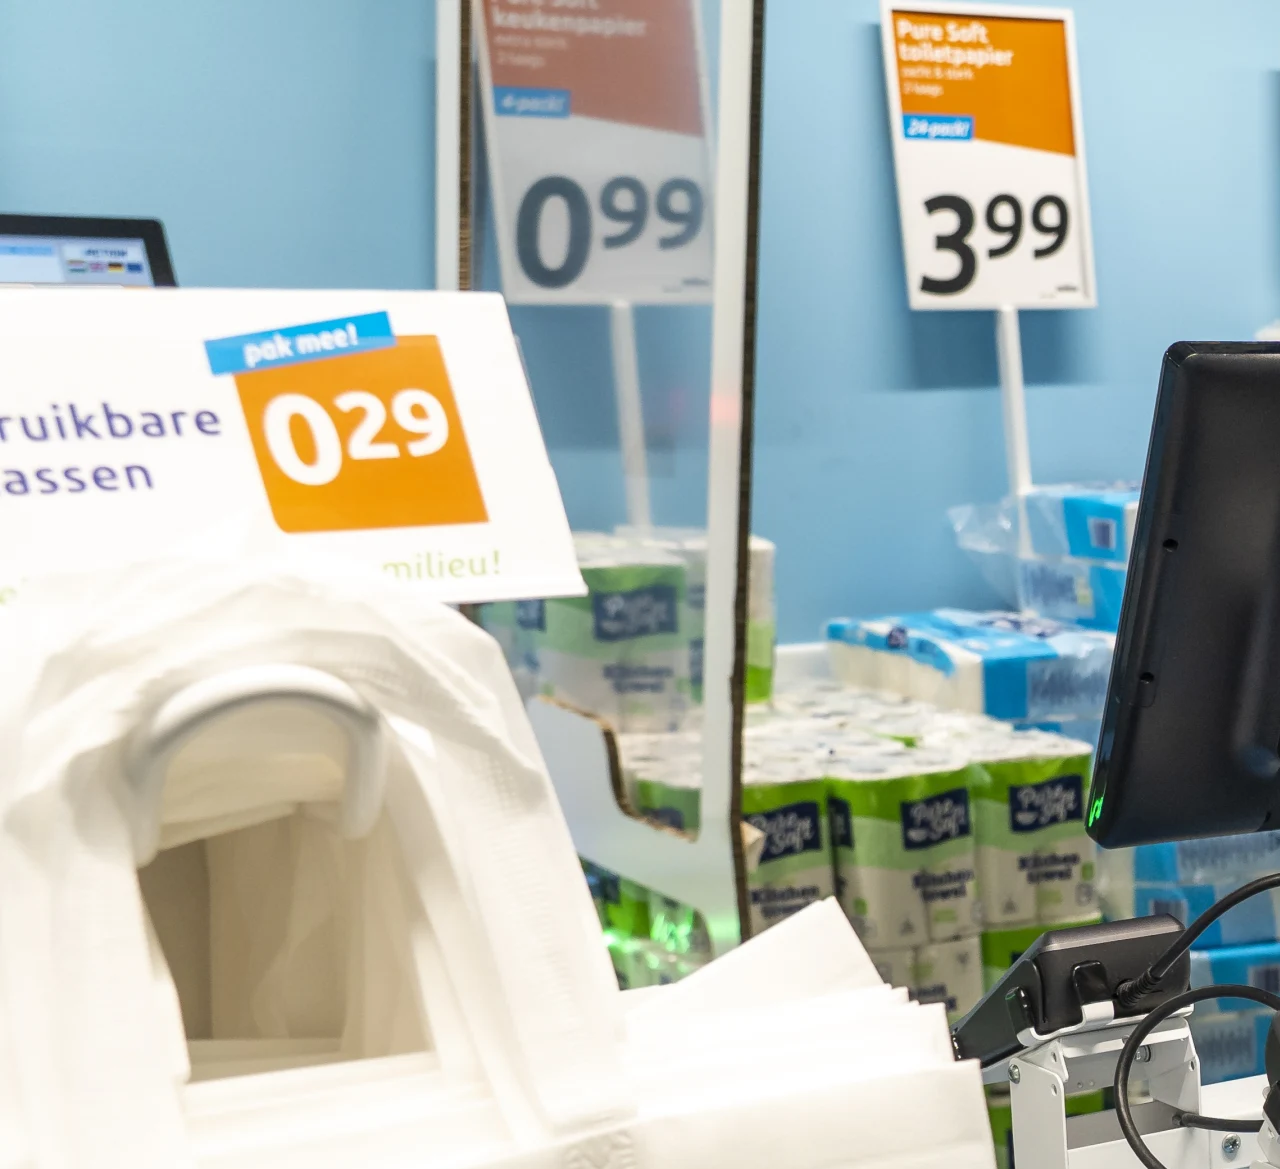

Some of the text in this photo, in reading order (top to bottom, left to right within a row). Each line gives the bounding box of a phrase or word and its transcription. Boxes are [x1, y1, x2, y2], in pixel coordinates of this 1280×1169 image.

[897, 19, 990, 43] Pure Soft
[898, 42, 1014, 68] toiletpapier
[242, 322, 359, 368] pak mee!
[0, 403, 222, 443] ruikbare
[3, 463, 154, 497] assen
